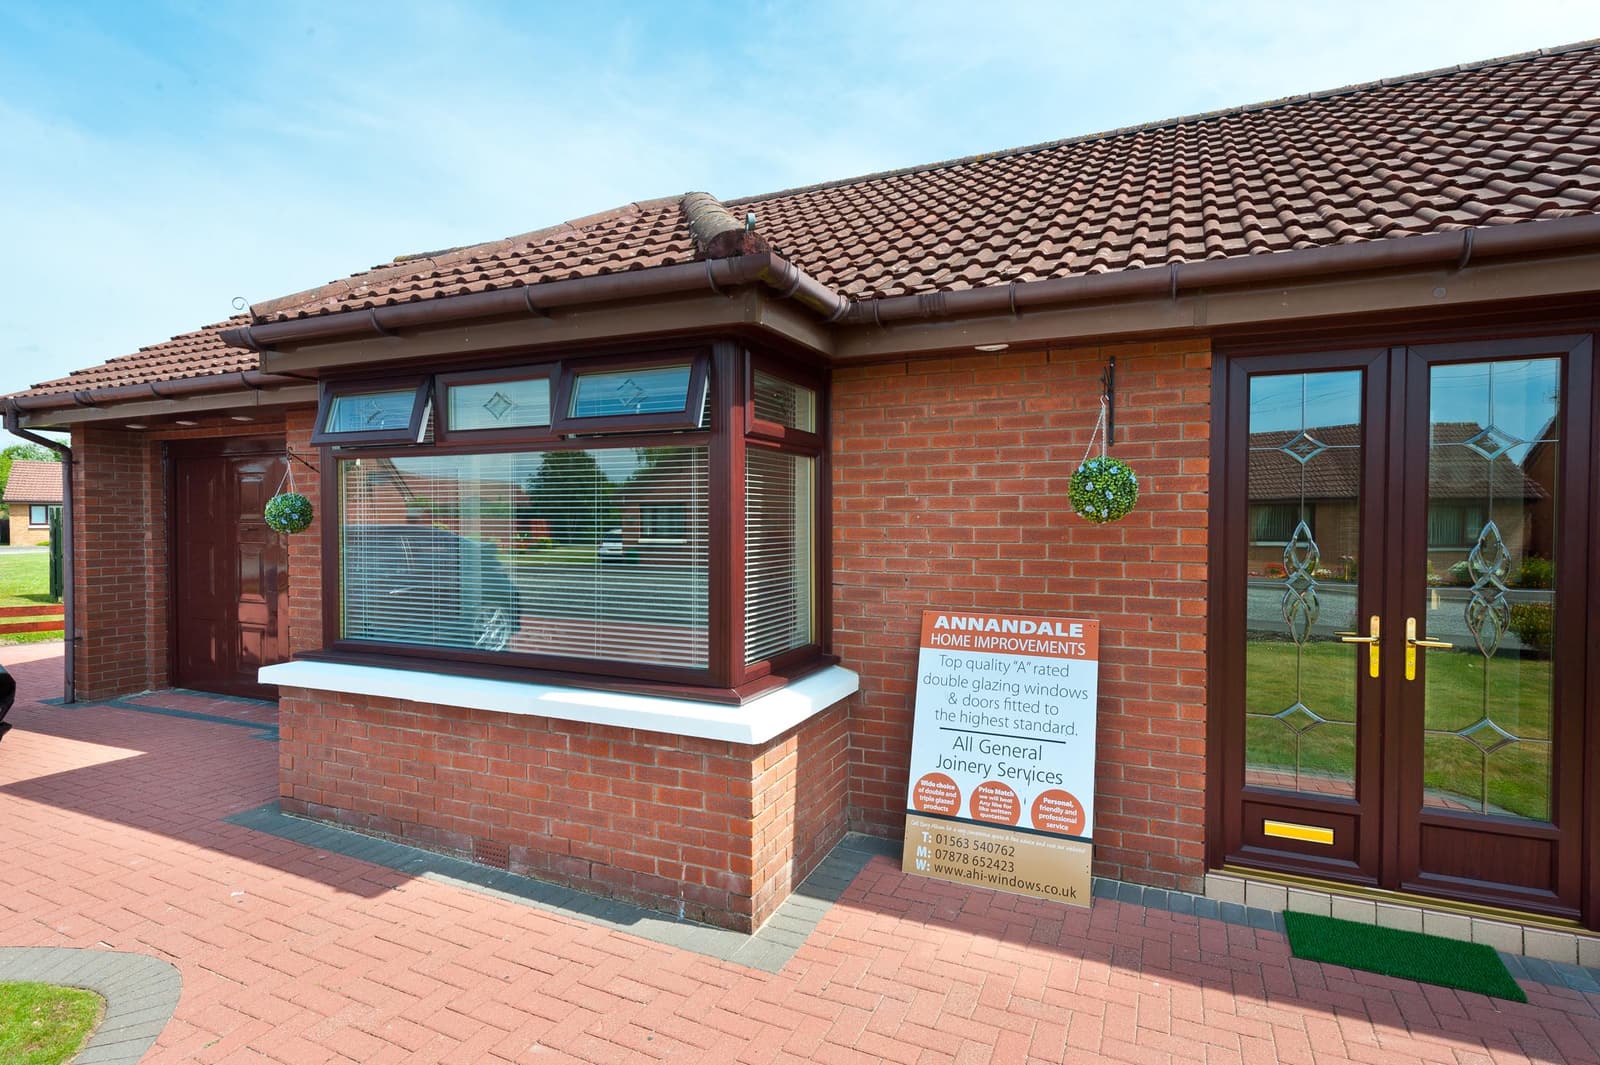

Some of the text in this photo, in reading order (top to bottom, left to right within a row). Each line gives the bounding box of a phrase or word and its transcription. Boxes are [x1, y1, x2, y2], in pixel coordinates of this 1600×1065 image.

[934, 615, 1083, 638] ANNANDALE
[930, 632, 1086, 656] HOME IMPROVEMENTS
[939, 654, 962, 670] Top
[966, 658, 1010, 674] quality
[1033, 664, 1069, 677] rated
[923, 672, 1088, 700] double glazing windows
[948, 692, 1059, 716] & doors fitted to
[935, 709, 1078, 737] the highest standard.
[952, 736, 1042, 760] All General
[936, 754, 1063, 785] Joinery Services
[925, 788, 945, 796] double
[936, 782, 956, 790] choice
[979, 786, 1014, 797] Price Match
[923, 803, 949, 812] products
[1039, 804, 1063, 815] friendly
[1043, 797, 1074, 808] Personal,
[1038, 813, 1078, 824] professional
[1046, 822, 1069, 831] service
[922, 831, 932, 844] T:
[935, 833, 969, 849] 01563
[973, 840, 1015, 858] 540762
[916, 846, 1015, 873] M: 07878 652423
[915, 858, 1078, 899] W: www.ahi-windows.co.uk
